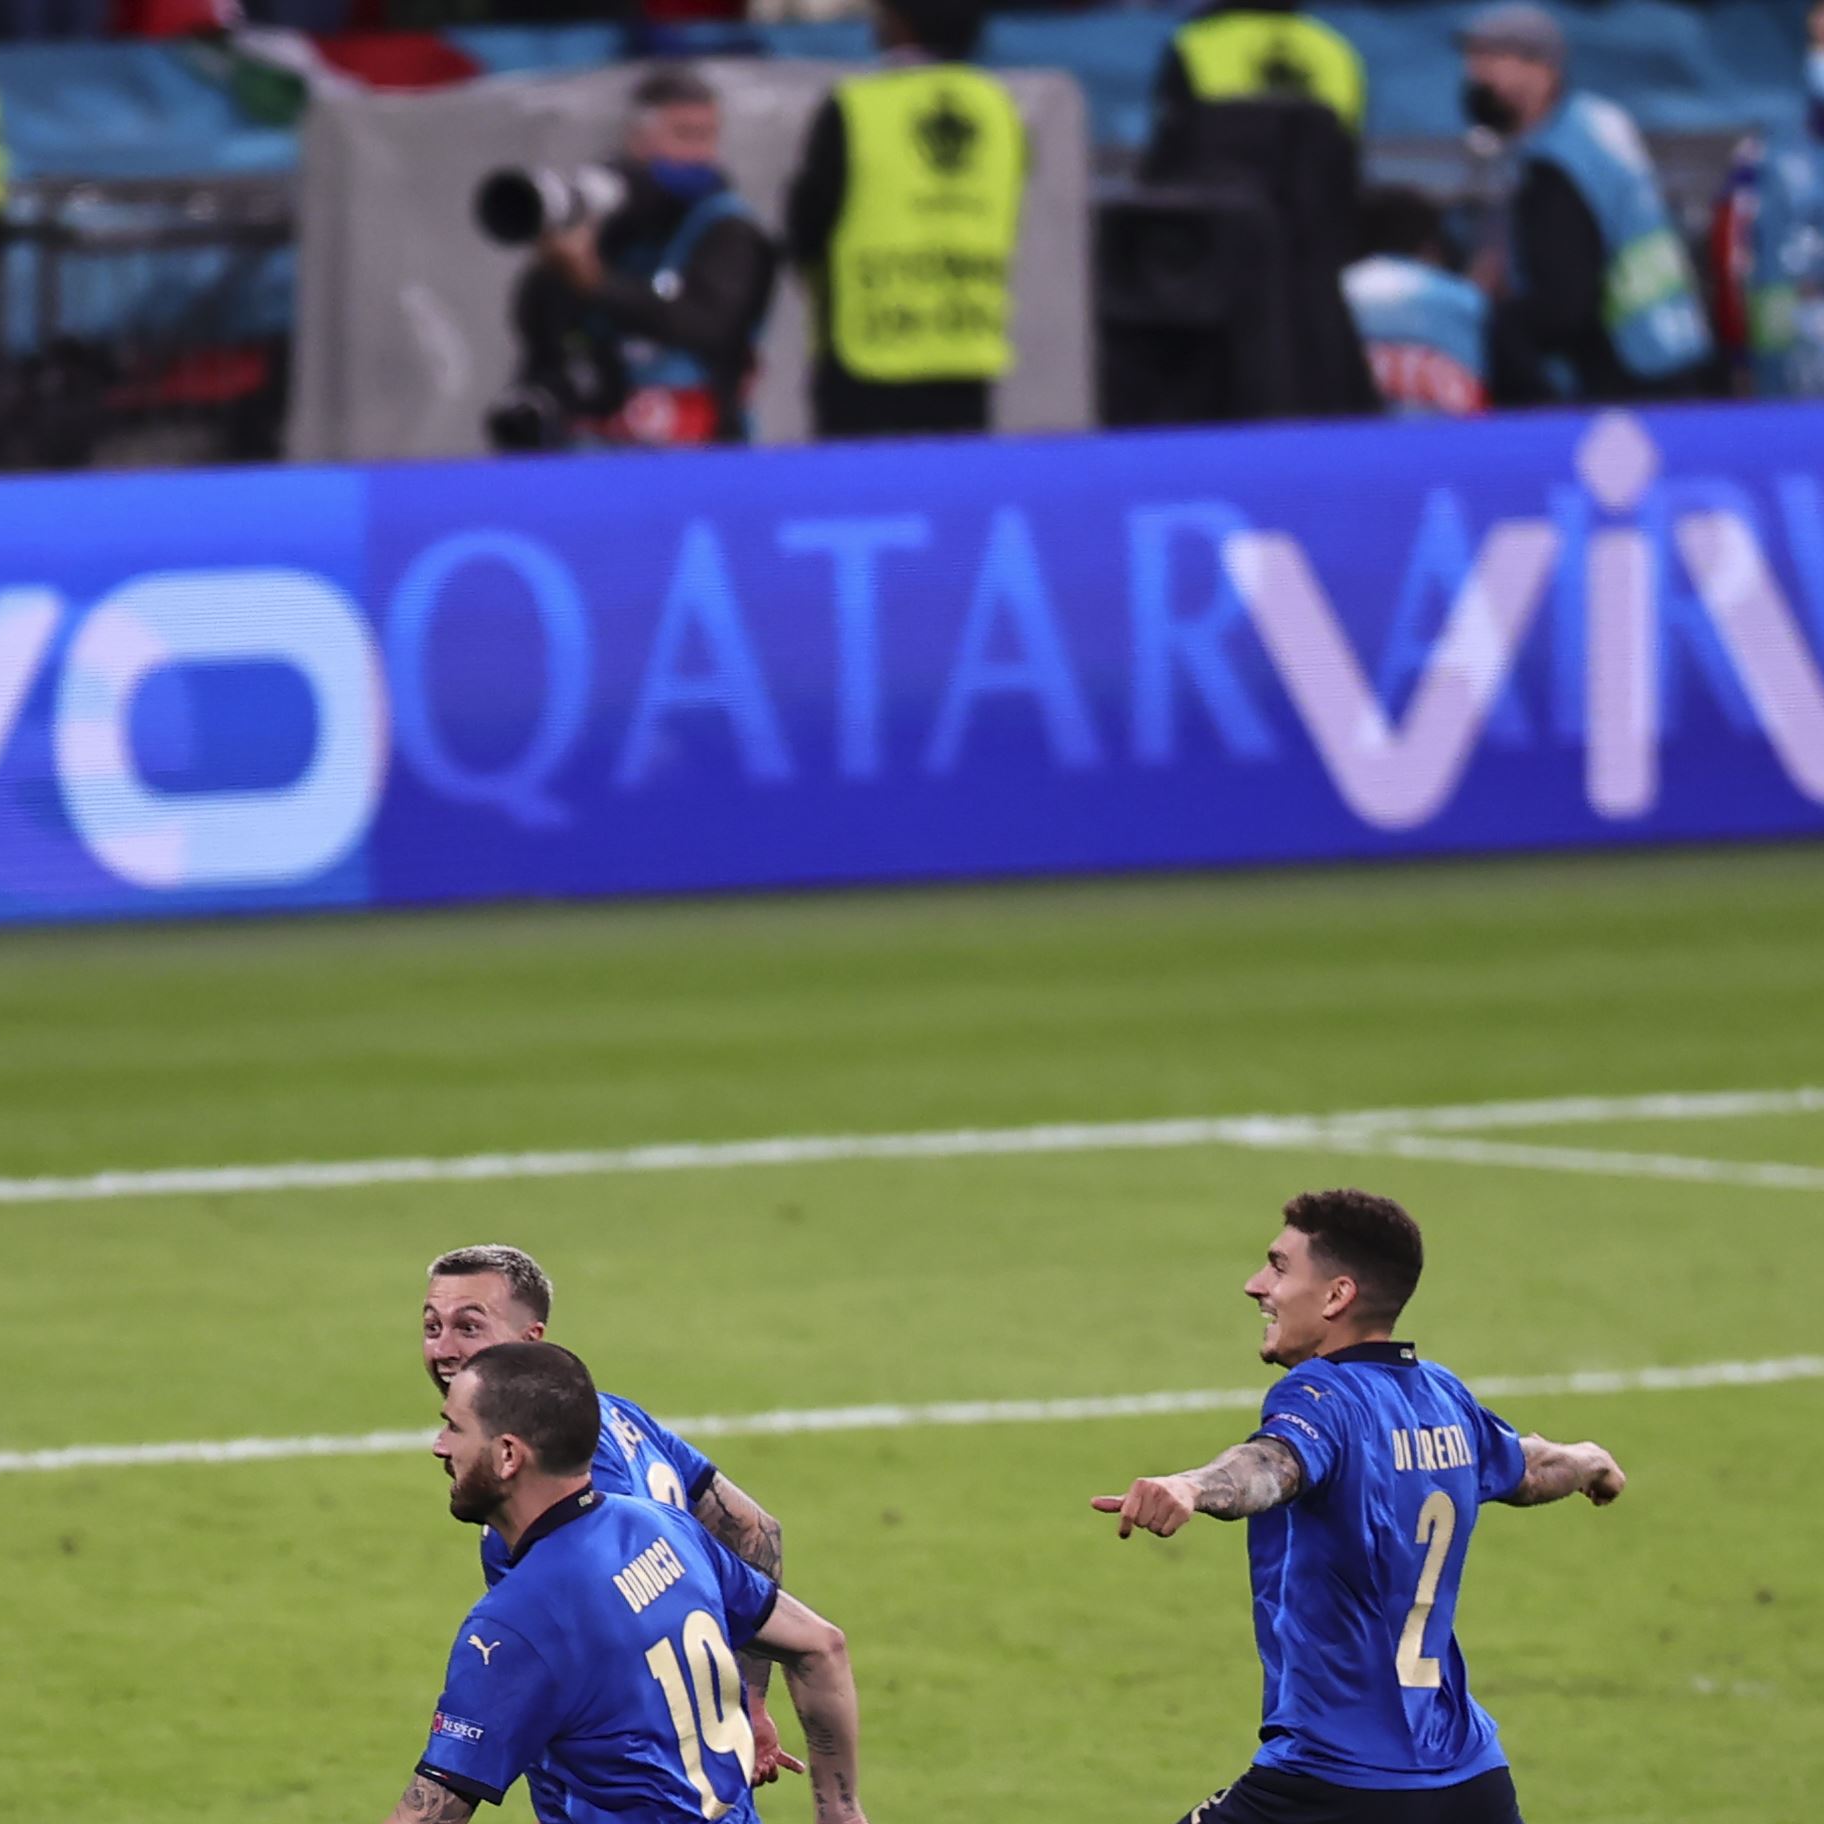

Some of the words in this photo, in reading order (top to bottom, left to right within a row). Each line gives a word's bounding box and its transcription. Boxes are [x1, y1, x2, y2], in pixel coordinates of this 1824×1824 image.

[382, 498, 1278, 830] QATAR
[612, 1536, 686, 1614] BONUCCI
[1395, 1489, 1456, 1689] 2
[441, 1719, 484, 1740] RESPECT
[643, 1609, 756, 1821] 19
